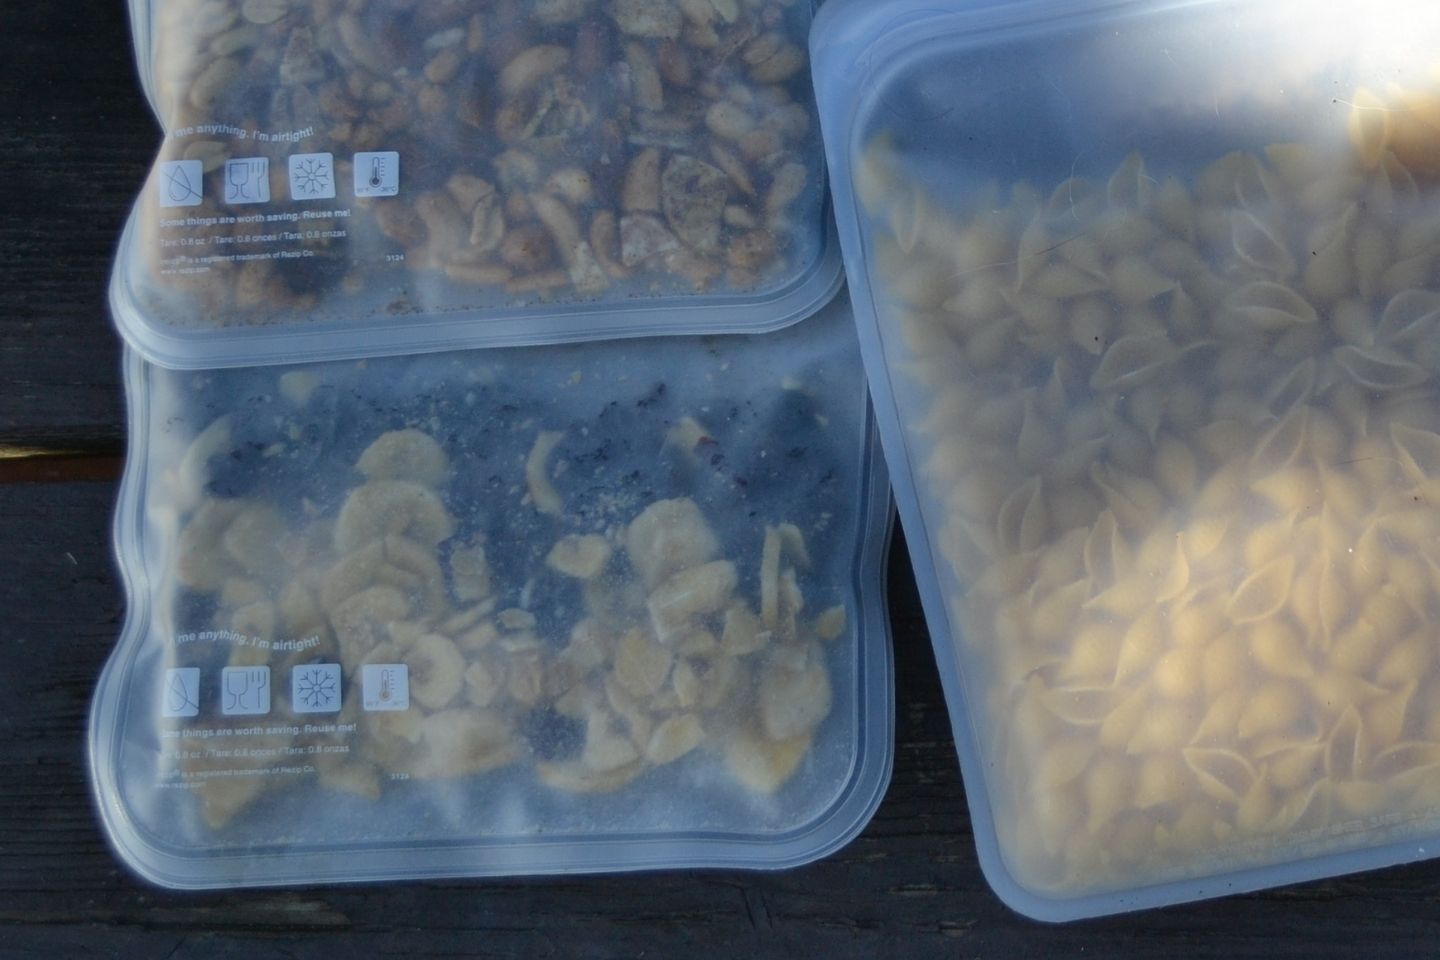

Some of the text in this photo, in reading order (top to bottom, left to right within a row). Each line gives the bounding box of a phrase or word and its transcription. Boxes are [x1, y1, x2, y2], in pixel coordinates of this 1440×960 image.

[176, 124, 314, 142] me anything. I'm airtight!
[187, 216, 218, 226] things
[237, 214, 264, 223] worth
[267, 212, 300, 222] saving.
[303, 210, 332, 219] Reuse
[334, 208, 351, 217] me!
[322, 229, 347, 238] onzas
[178, 629, 321, 652] me anything. I'm airtight!
[183, 728, 214, 739] things
[216, 728, 232, 737] are
[235, 726, 264, 736] worth
[266, 725, 302, 736] saving.
[304, 724, 336, 733] Reuse
[337, 722, 357, 732] me!
[324, 744, 349, 753] onzas
